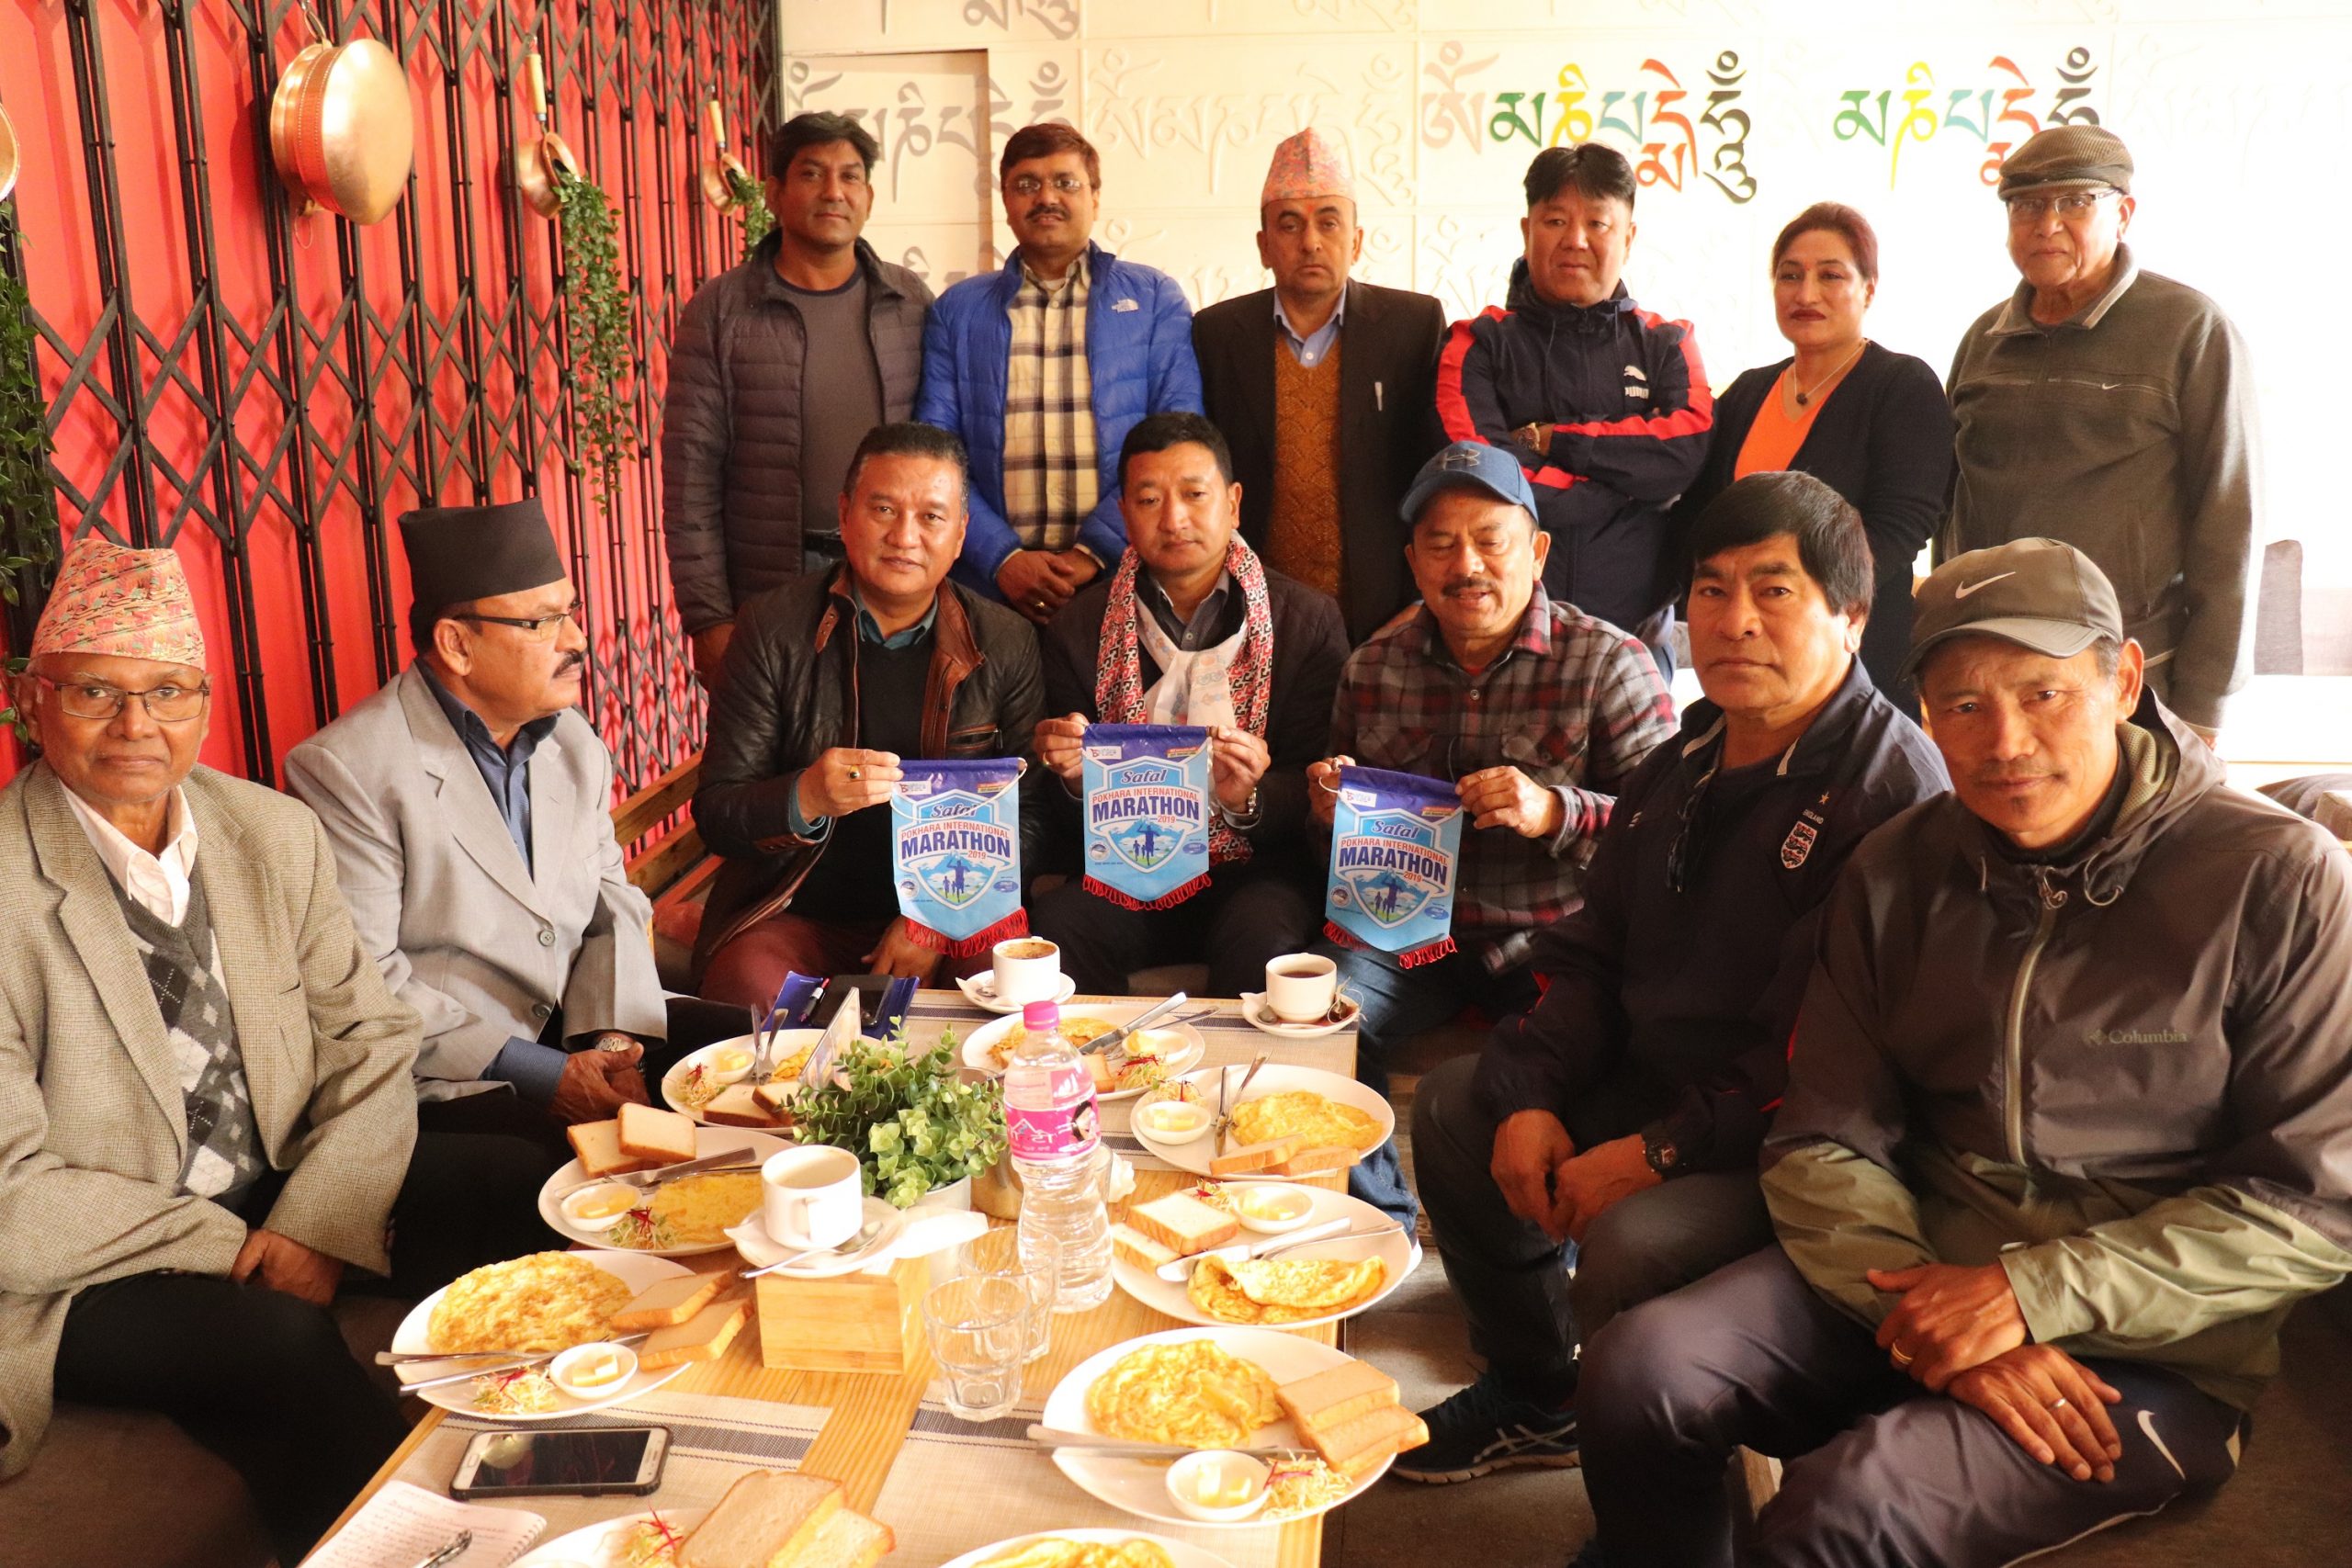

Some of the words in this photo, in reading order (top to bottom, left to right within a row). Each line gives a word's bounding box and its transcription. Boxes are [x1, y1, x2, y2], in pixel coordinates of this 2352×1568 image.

[1121, 769, 1167, 784] Safal
[1092, 789, 1131, 804] POKHARA
[1134, 787, 1199, 802] INTERNATIONAL
[1092, 795, 1199, 824] MARATHON
[1158, 815, 1177, 824] 2019
[901, 822, 941, 840] POKHARA
[943, 821, 1010, 839] INTERNATIONAL
[1372, 819, 1419, 840] Safal
[901, 829, 1011, 860] MARATHON
[1340, 838, 1381, 848] POKHARA
[1383, 840, 1448, 865] INTERNATIONAL
[967, 850, 987, 860] 2019
[1339, 846, 1448, 886] MARATHON
[1403, 871, 1422, 883] 2019
[2109, 1029, 2188, 1044] Columbia
